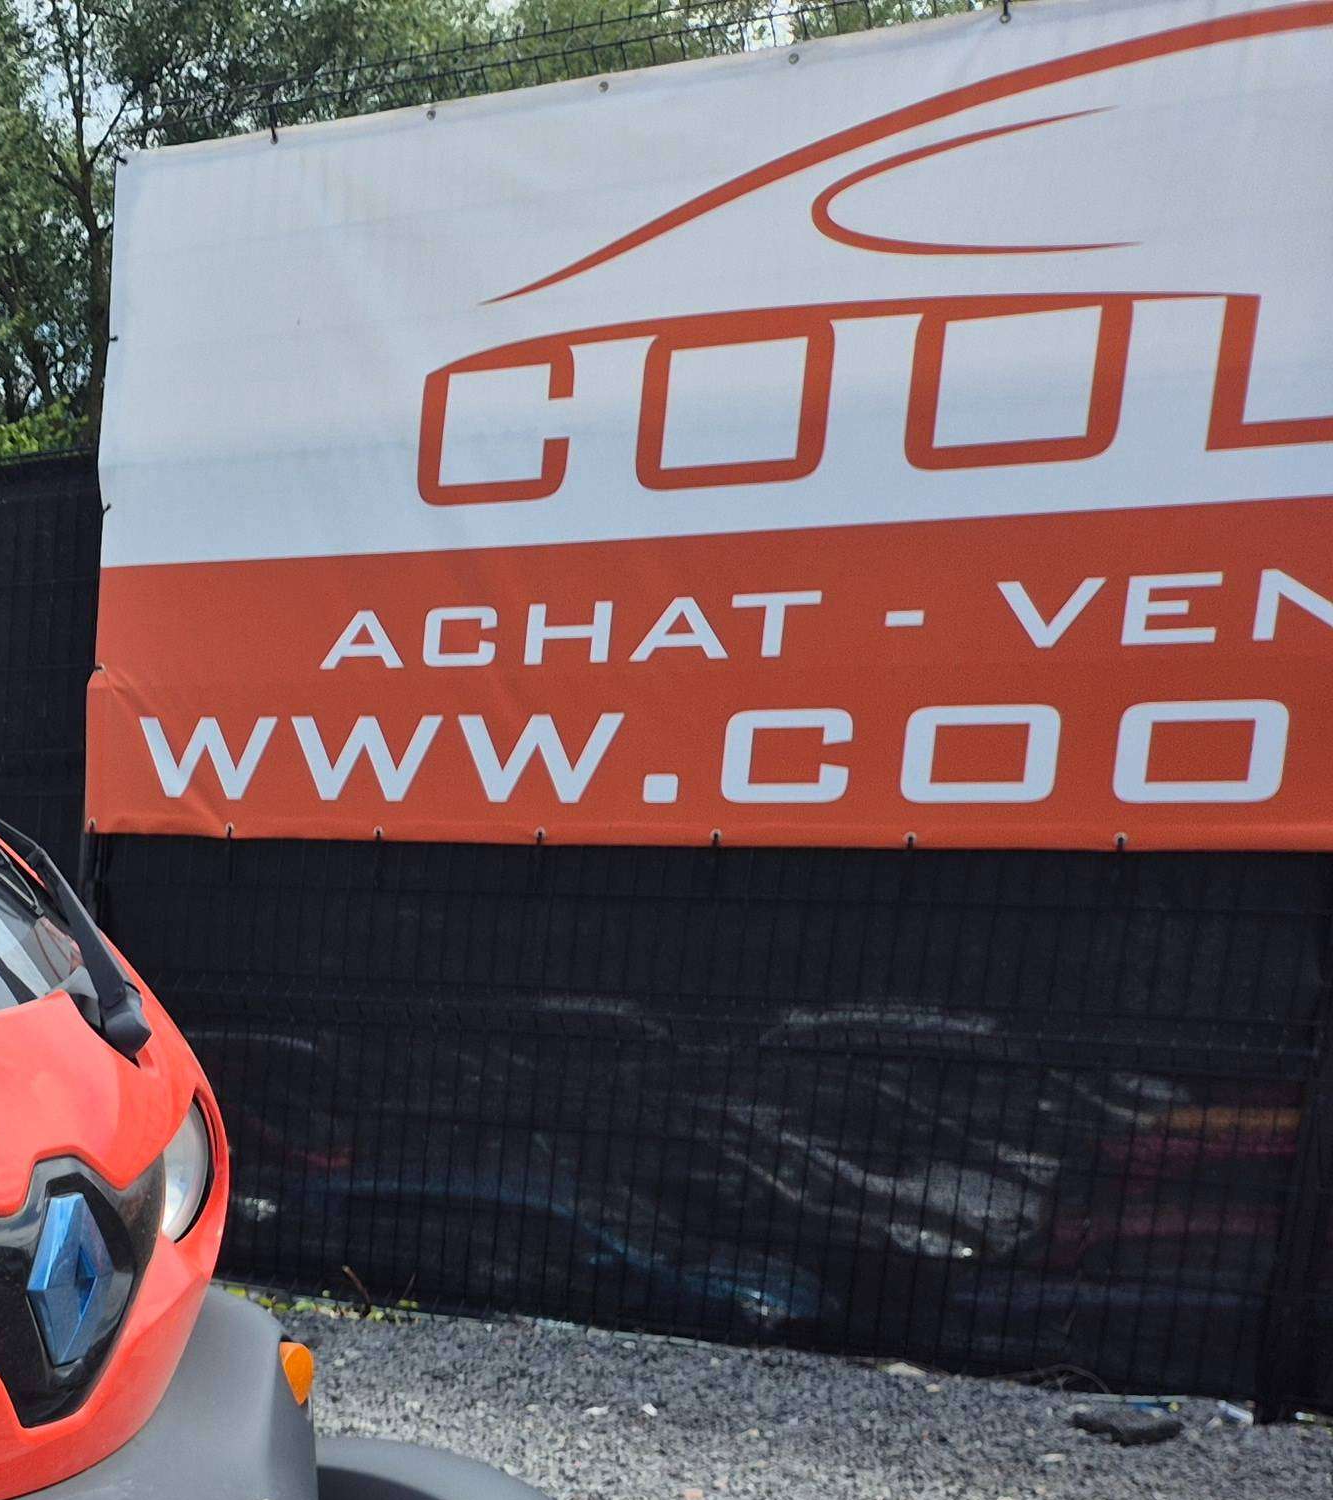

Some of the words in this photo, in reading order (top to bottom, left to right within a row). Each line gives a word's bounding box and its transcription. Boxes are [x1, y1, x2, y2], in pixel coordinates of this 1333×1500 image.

[418, 292, 1333, 506] COOL
[319, 590, 823, 670] ACHAT
[884, 610, 925, 627] -
[997, 567, 1333, 649] VEN
[139, 699, 1290, 804] WWW.COO
